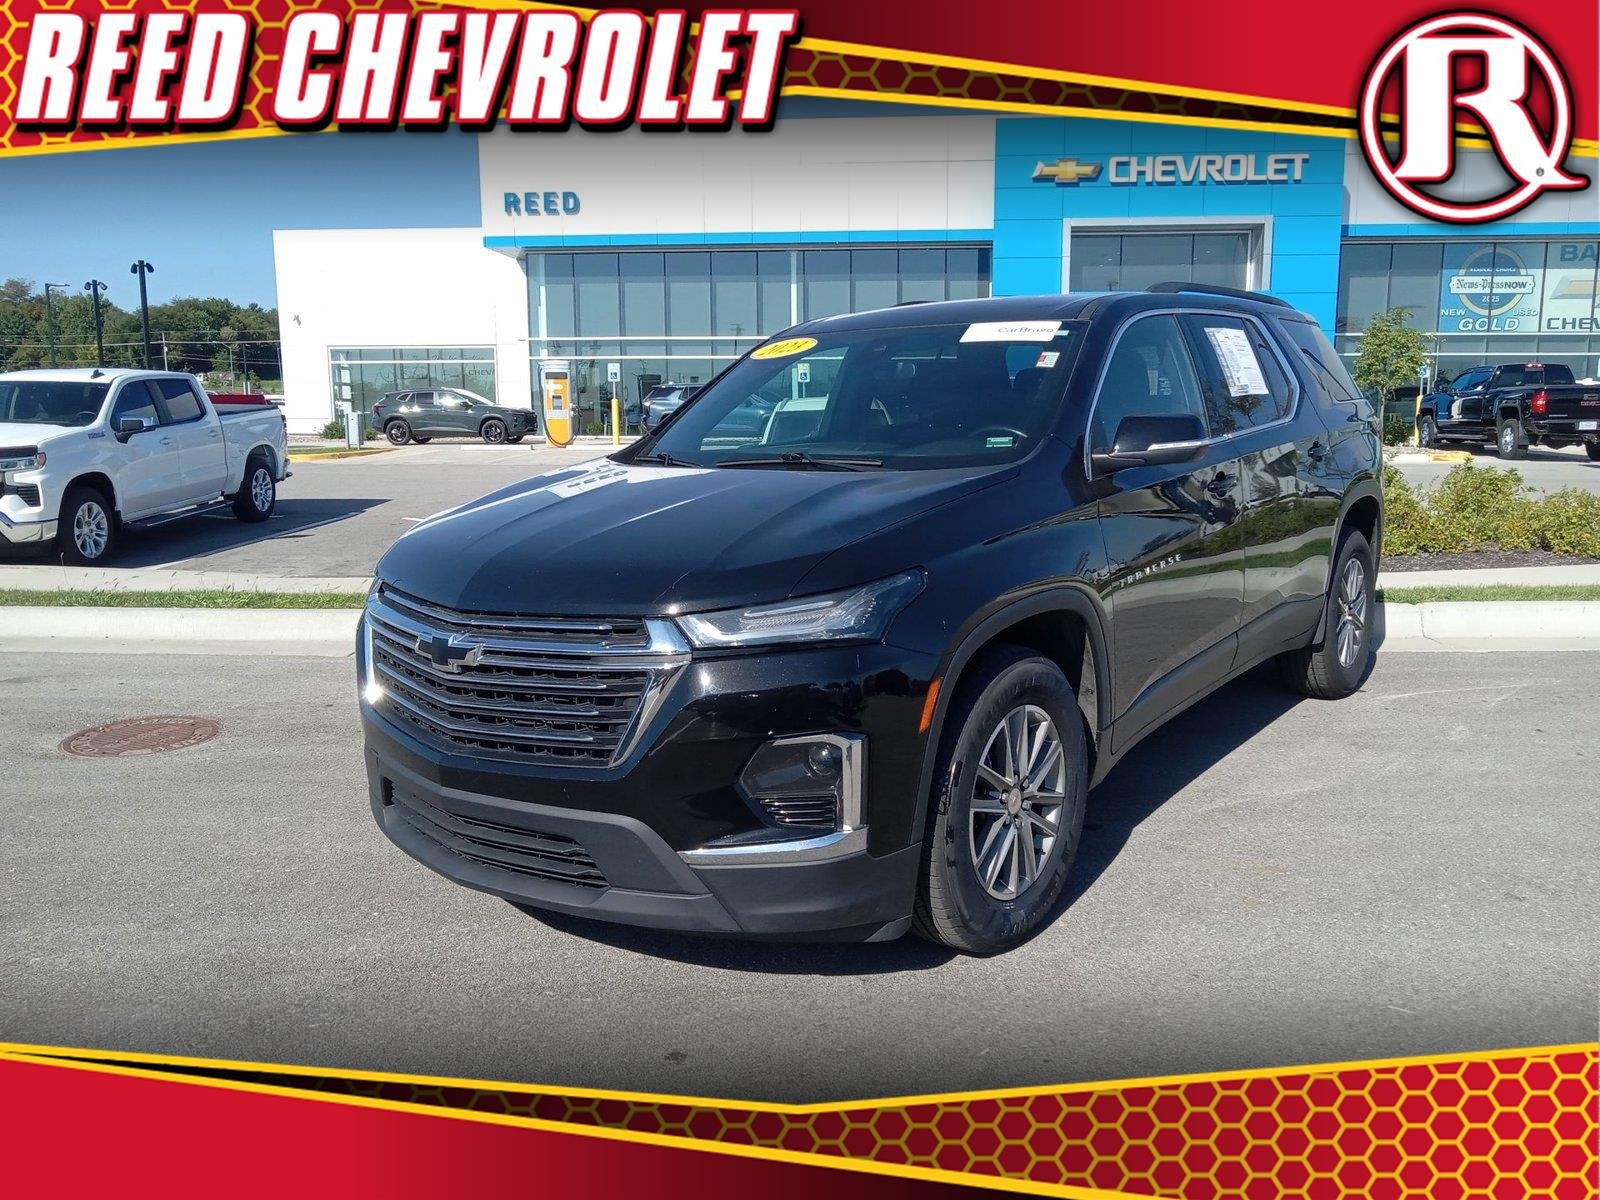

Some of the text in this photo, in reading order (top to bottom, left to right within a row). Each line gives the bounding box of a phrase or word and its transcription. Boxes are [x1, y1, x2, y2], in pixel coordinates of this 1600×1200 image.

[1108, 153, 1310, 184] CHEVROLET
[503, 191, 581, 216] REED
[1441, 308, 1538, 316] NEW USED
[997, 326, 1054, 334] CarBravo
[1458, 317, 1520, 331] GOLD
[1119, 553, 1182, 588] TRAVERSE
